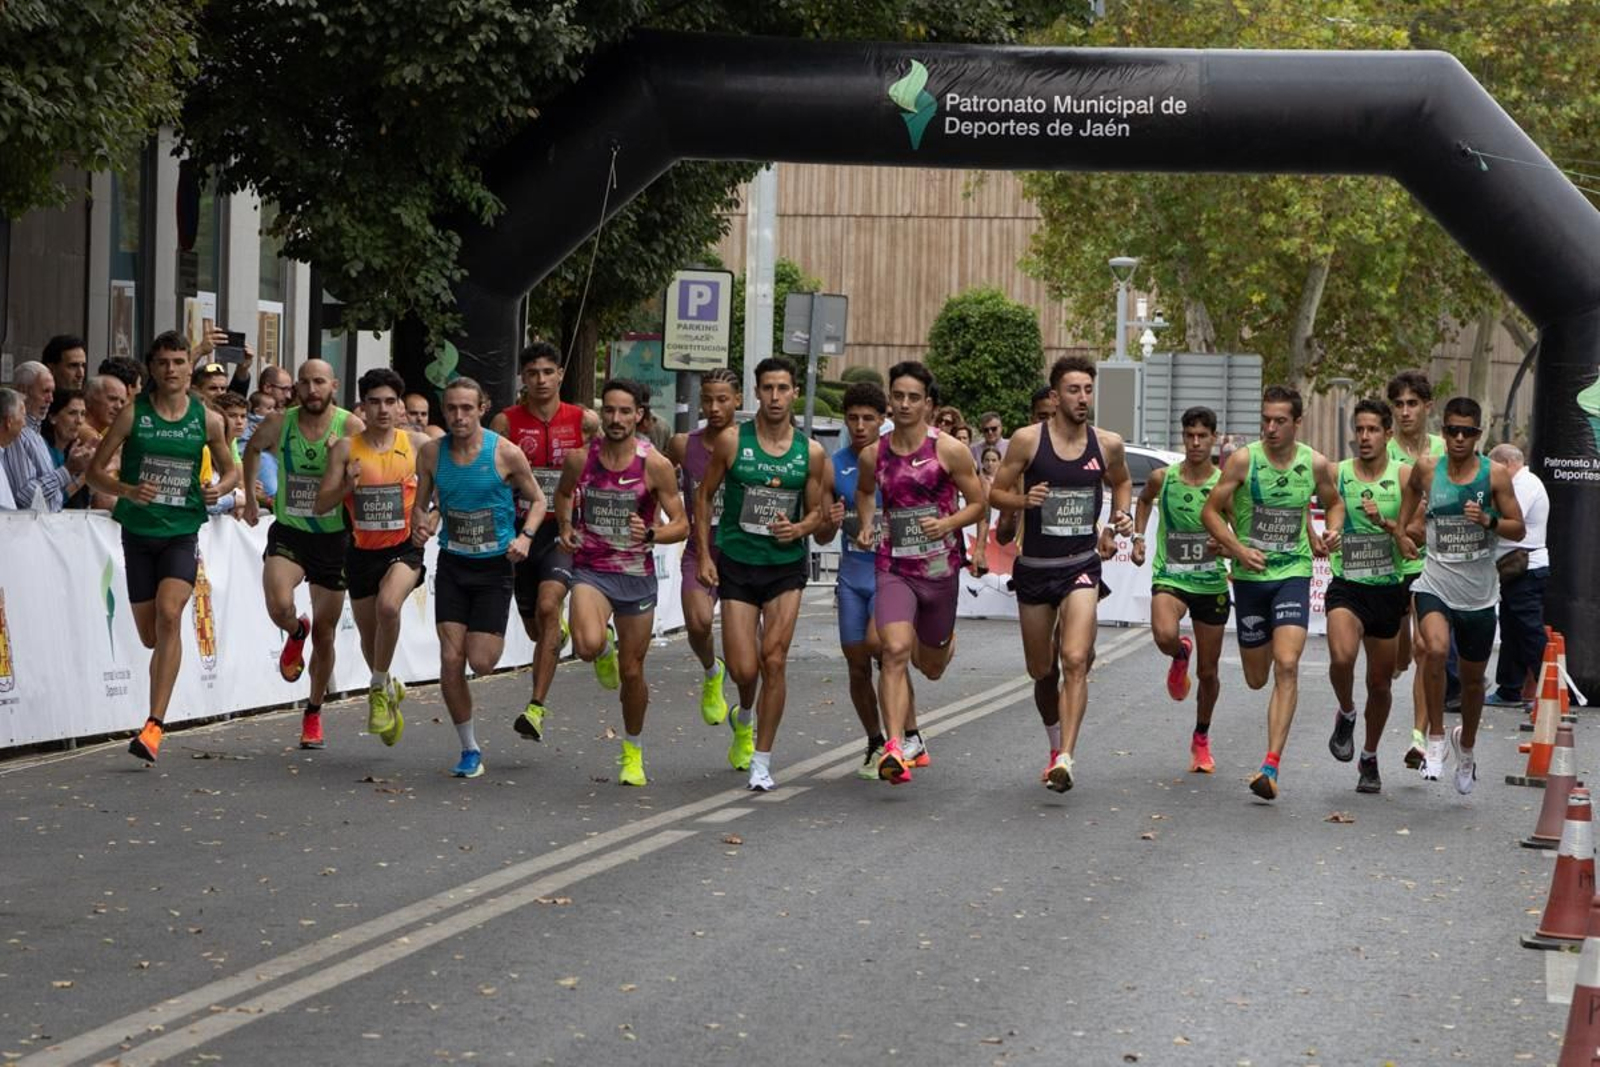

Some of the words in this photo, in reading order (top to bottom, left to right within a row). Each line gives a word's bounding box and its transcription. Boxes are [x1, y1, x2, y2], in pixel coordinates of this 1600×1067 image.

[946, 93, 1046, 113] Patronato
[1053, 95, 1154, 118] Municipal
[1160, 98, 1187, 114] de
[944, 117, 1040, 138] Deportes
[1046, 119, 1073, 136] de
[1079, 118, 1130, 137] Jaén
[687, 284, 712, 317] P
[676, 323, 718, 332] PARKING
[666, 343, 727, 352] CONSTITUCIÓN
[1544, 457, 1590, 468] Patronato
[1554, 469, 1600, 481] Deportes
[363, 501, 393, 512] ÓSCAR
[593, 506, 629, 517] IGNACIO
[1057, 505, 1084, 516] ADAM
[595, 516, 626, 526] FONTES
[1257, 521, 1297, 533] ALBERTO
[1440, 532, 1484, 543] MOHAMED
[1180, 543, 1203, 560] 19
[1351, 549, 1384, 560] MIGUEL
